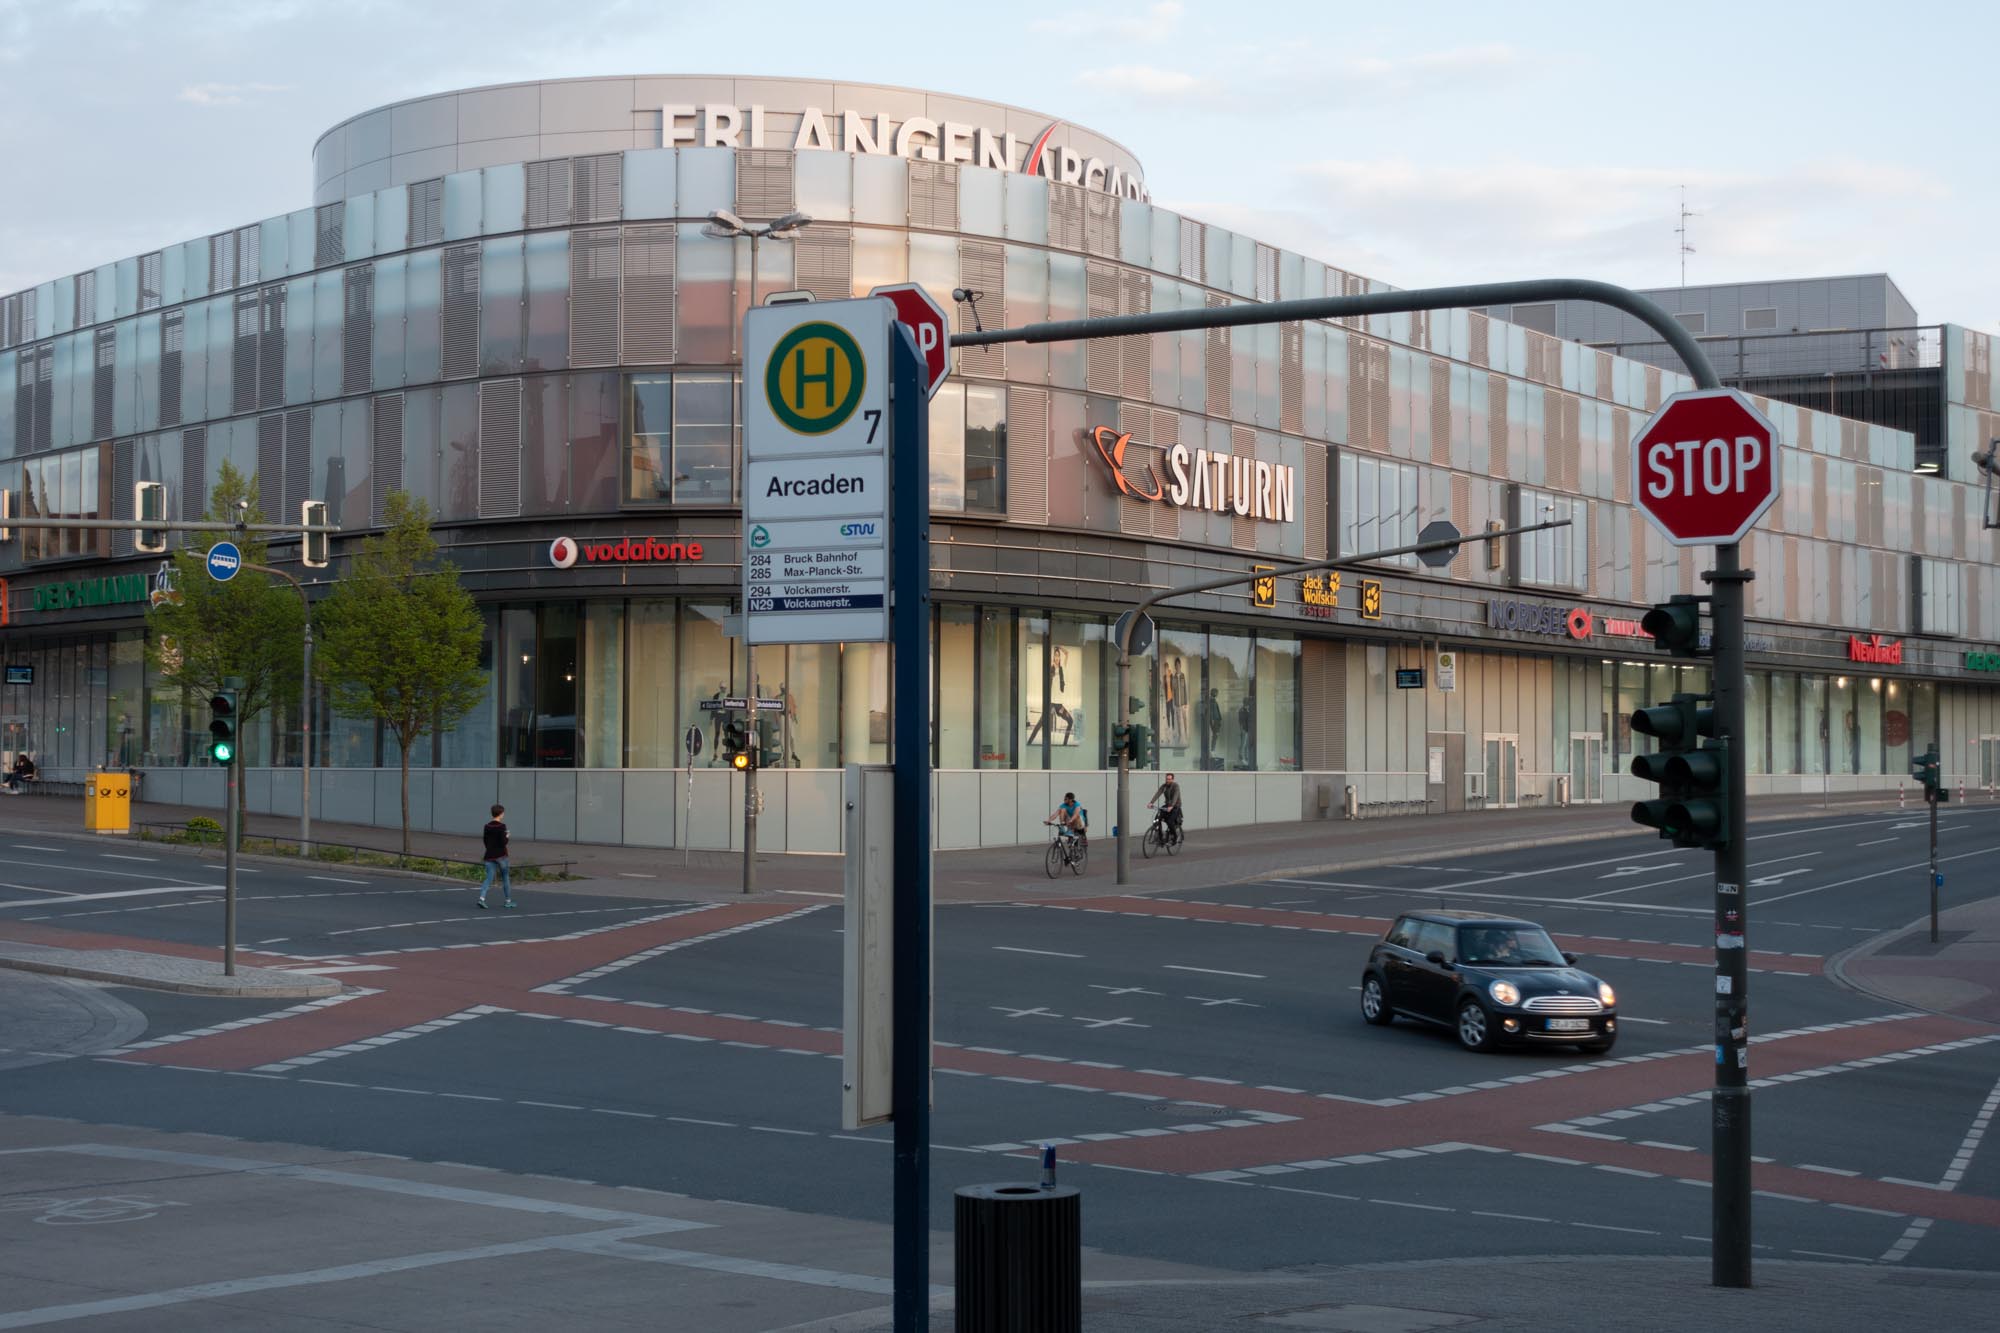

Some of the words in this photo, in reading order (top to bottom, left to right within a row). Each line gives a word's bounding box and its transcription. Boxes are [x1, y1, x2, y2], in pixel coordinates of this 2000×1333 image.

[795, 347, 835, 409] H
[864, 409, 882, 444] 7
[1647, 436, 1761, 499] STOP
[766, 474, 864, 497] Arcaden
[1170, 443, 1294, 522] SATURN
[583, 536, 703, 561] vodafone
[750, 555, 771, 566] 284
[784, 554, 813, 564] Bruck
[816, 552, 858, 563] Bahnhof
[750, 568, 771, 579] 285
[784, 565, 863, 577] Max-Planck-Str.
[1303, 573, 1323, 589] Jack
[33, 574, 147, 611] DEICHMANN
[750, 586, 771, 597] 294
[784, 584, 851, 595] Volckamerstr.
[1303, 588, 1338, 607] Wolfskin
[750, 599, 774, 610] N29
[784, 598, 852, 609] Volckamerstr.
[1489, 600, 1567, 635] NORDSEE
